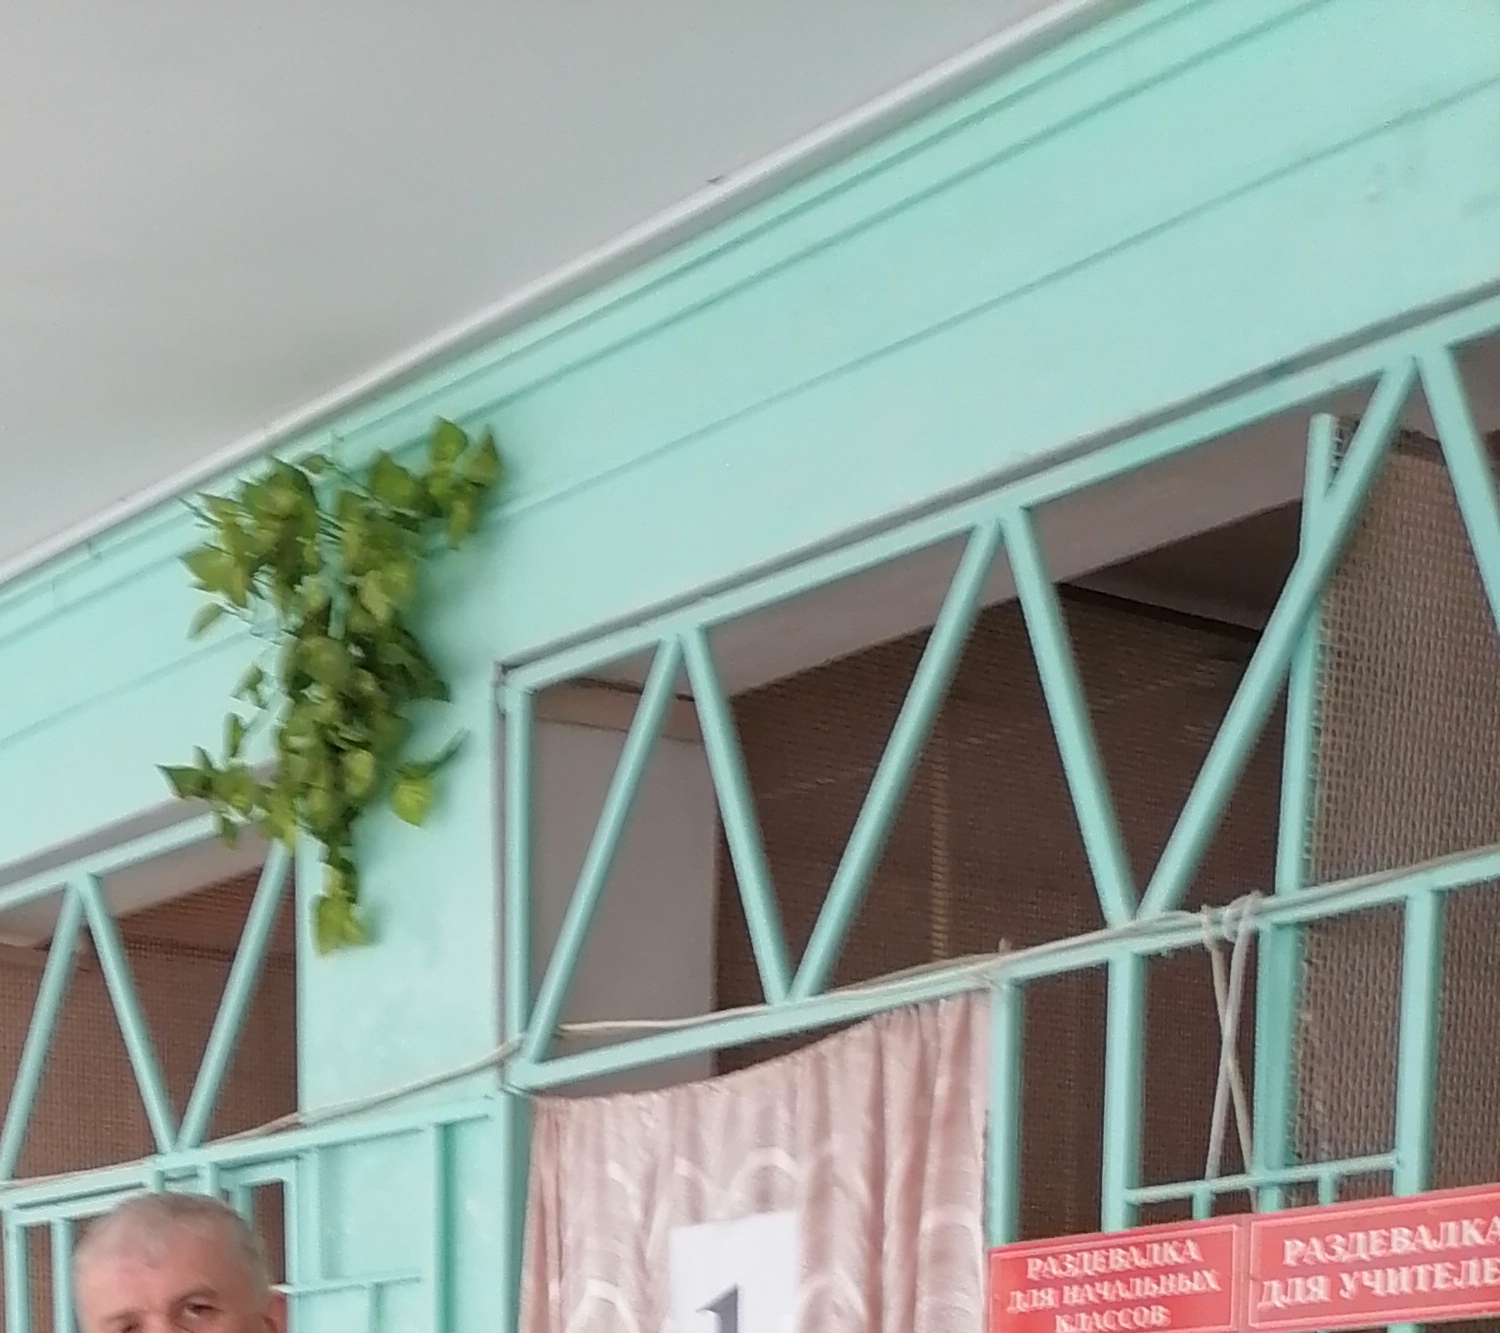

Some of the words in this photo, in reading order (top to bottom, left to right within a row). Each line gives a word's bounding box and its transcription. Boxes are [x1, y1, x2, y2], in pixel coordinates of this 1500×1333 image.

[1026, 1239, 1204, 1281] РАЗДЕВАЛКА
[1006, 1287, 1059, 1314] ДЛЯ
[1062, 1269, 1222, 1306] НАЧАЛЬНЫХ
[1257, 1275, 1331, 1309] ДЛЯ
